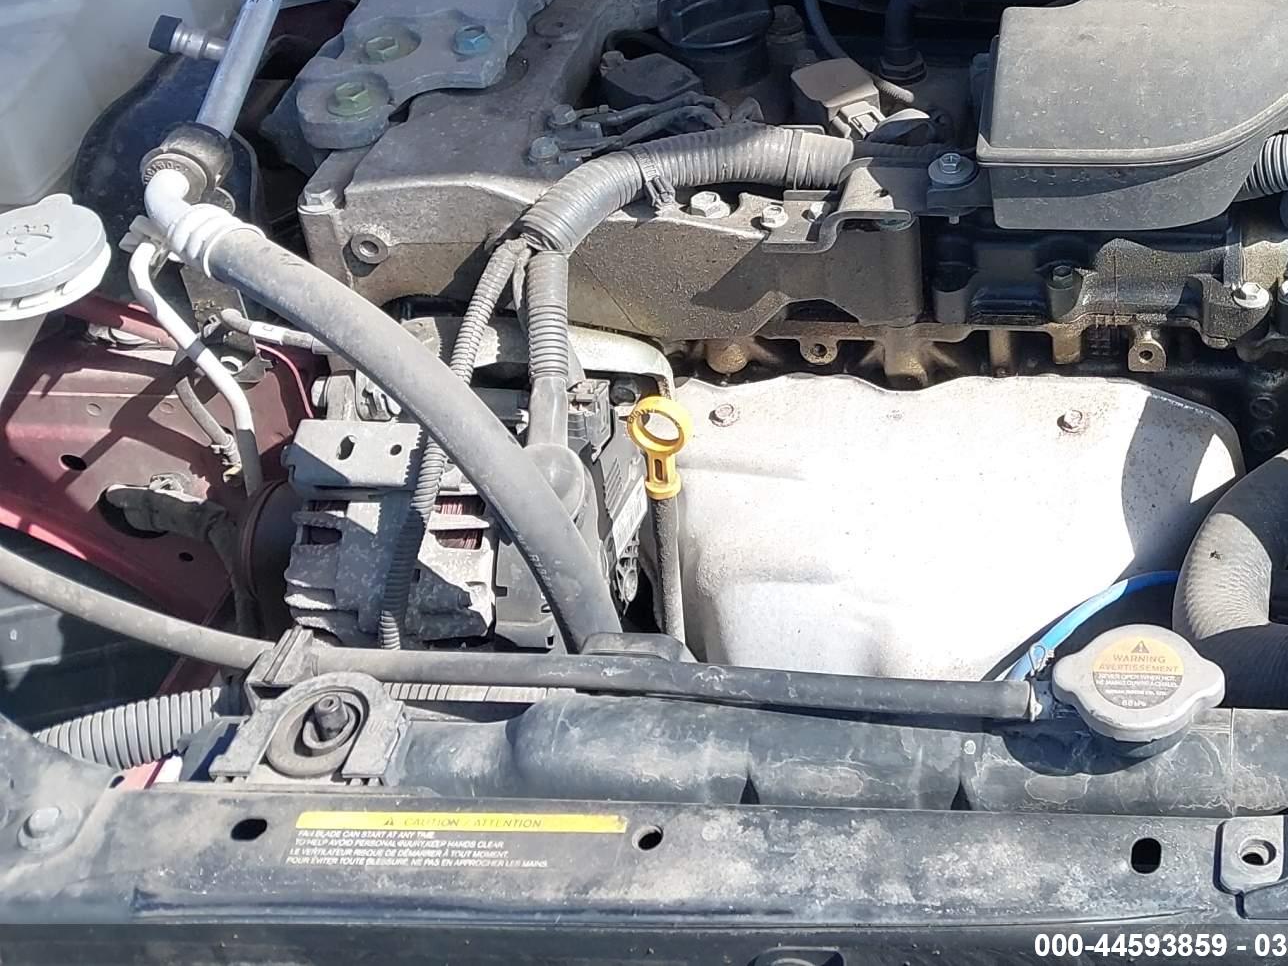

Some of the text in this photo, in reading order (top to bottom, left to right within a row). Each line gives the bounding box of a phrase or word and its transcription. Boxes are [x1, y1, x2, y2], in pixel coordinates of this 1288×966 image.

[1113, 654, 1166, 664] WARNING
[1099, 665, 1178, 673] AVERTISSEMENT
[404, 818, 459, 828] CAUTION
[474, 818, 542, 828] ATTENTION
[315, 830, 342, 839] BLADE
[342, 830, 361, 839] CAN
[361, 830, 387, 839] START
[386, 831, 398, 839] AT
[398, 831, 416, 839] ANY
[295, 838, 306, 846] TO
[306, 838, 329, 847] HELP
[328, 838, 354, 847] AVOID
[354, 838, 397, 848] PERSONAL
[447, 840, 477, 849] HANDS
[290, 848, 300, 856] LE
[302, 848, 353, 857] VENTILATEUR
[353, 848, 384, 857] RISQUE
[385, 848, 397, 857] DE
[450, 849, 473, 858] TOUT
[286, 856, 310, 865] POUR
[340, 857, 366, 866] TOUTE
[410, 858, 424, 867] NE
[424, 858, 441, 867] PAS
[441, 858, 454, 867] EN
[453, 859, 505, 867] APPROCHER
